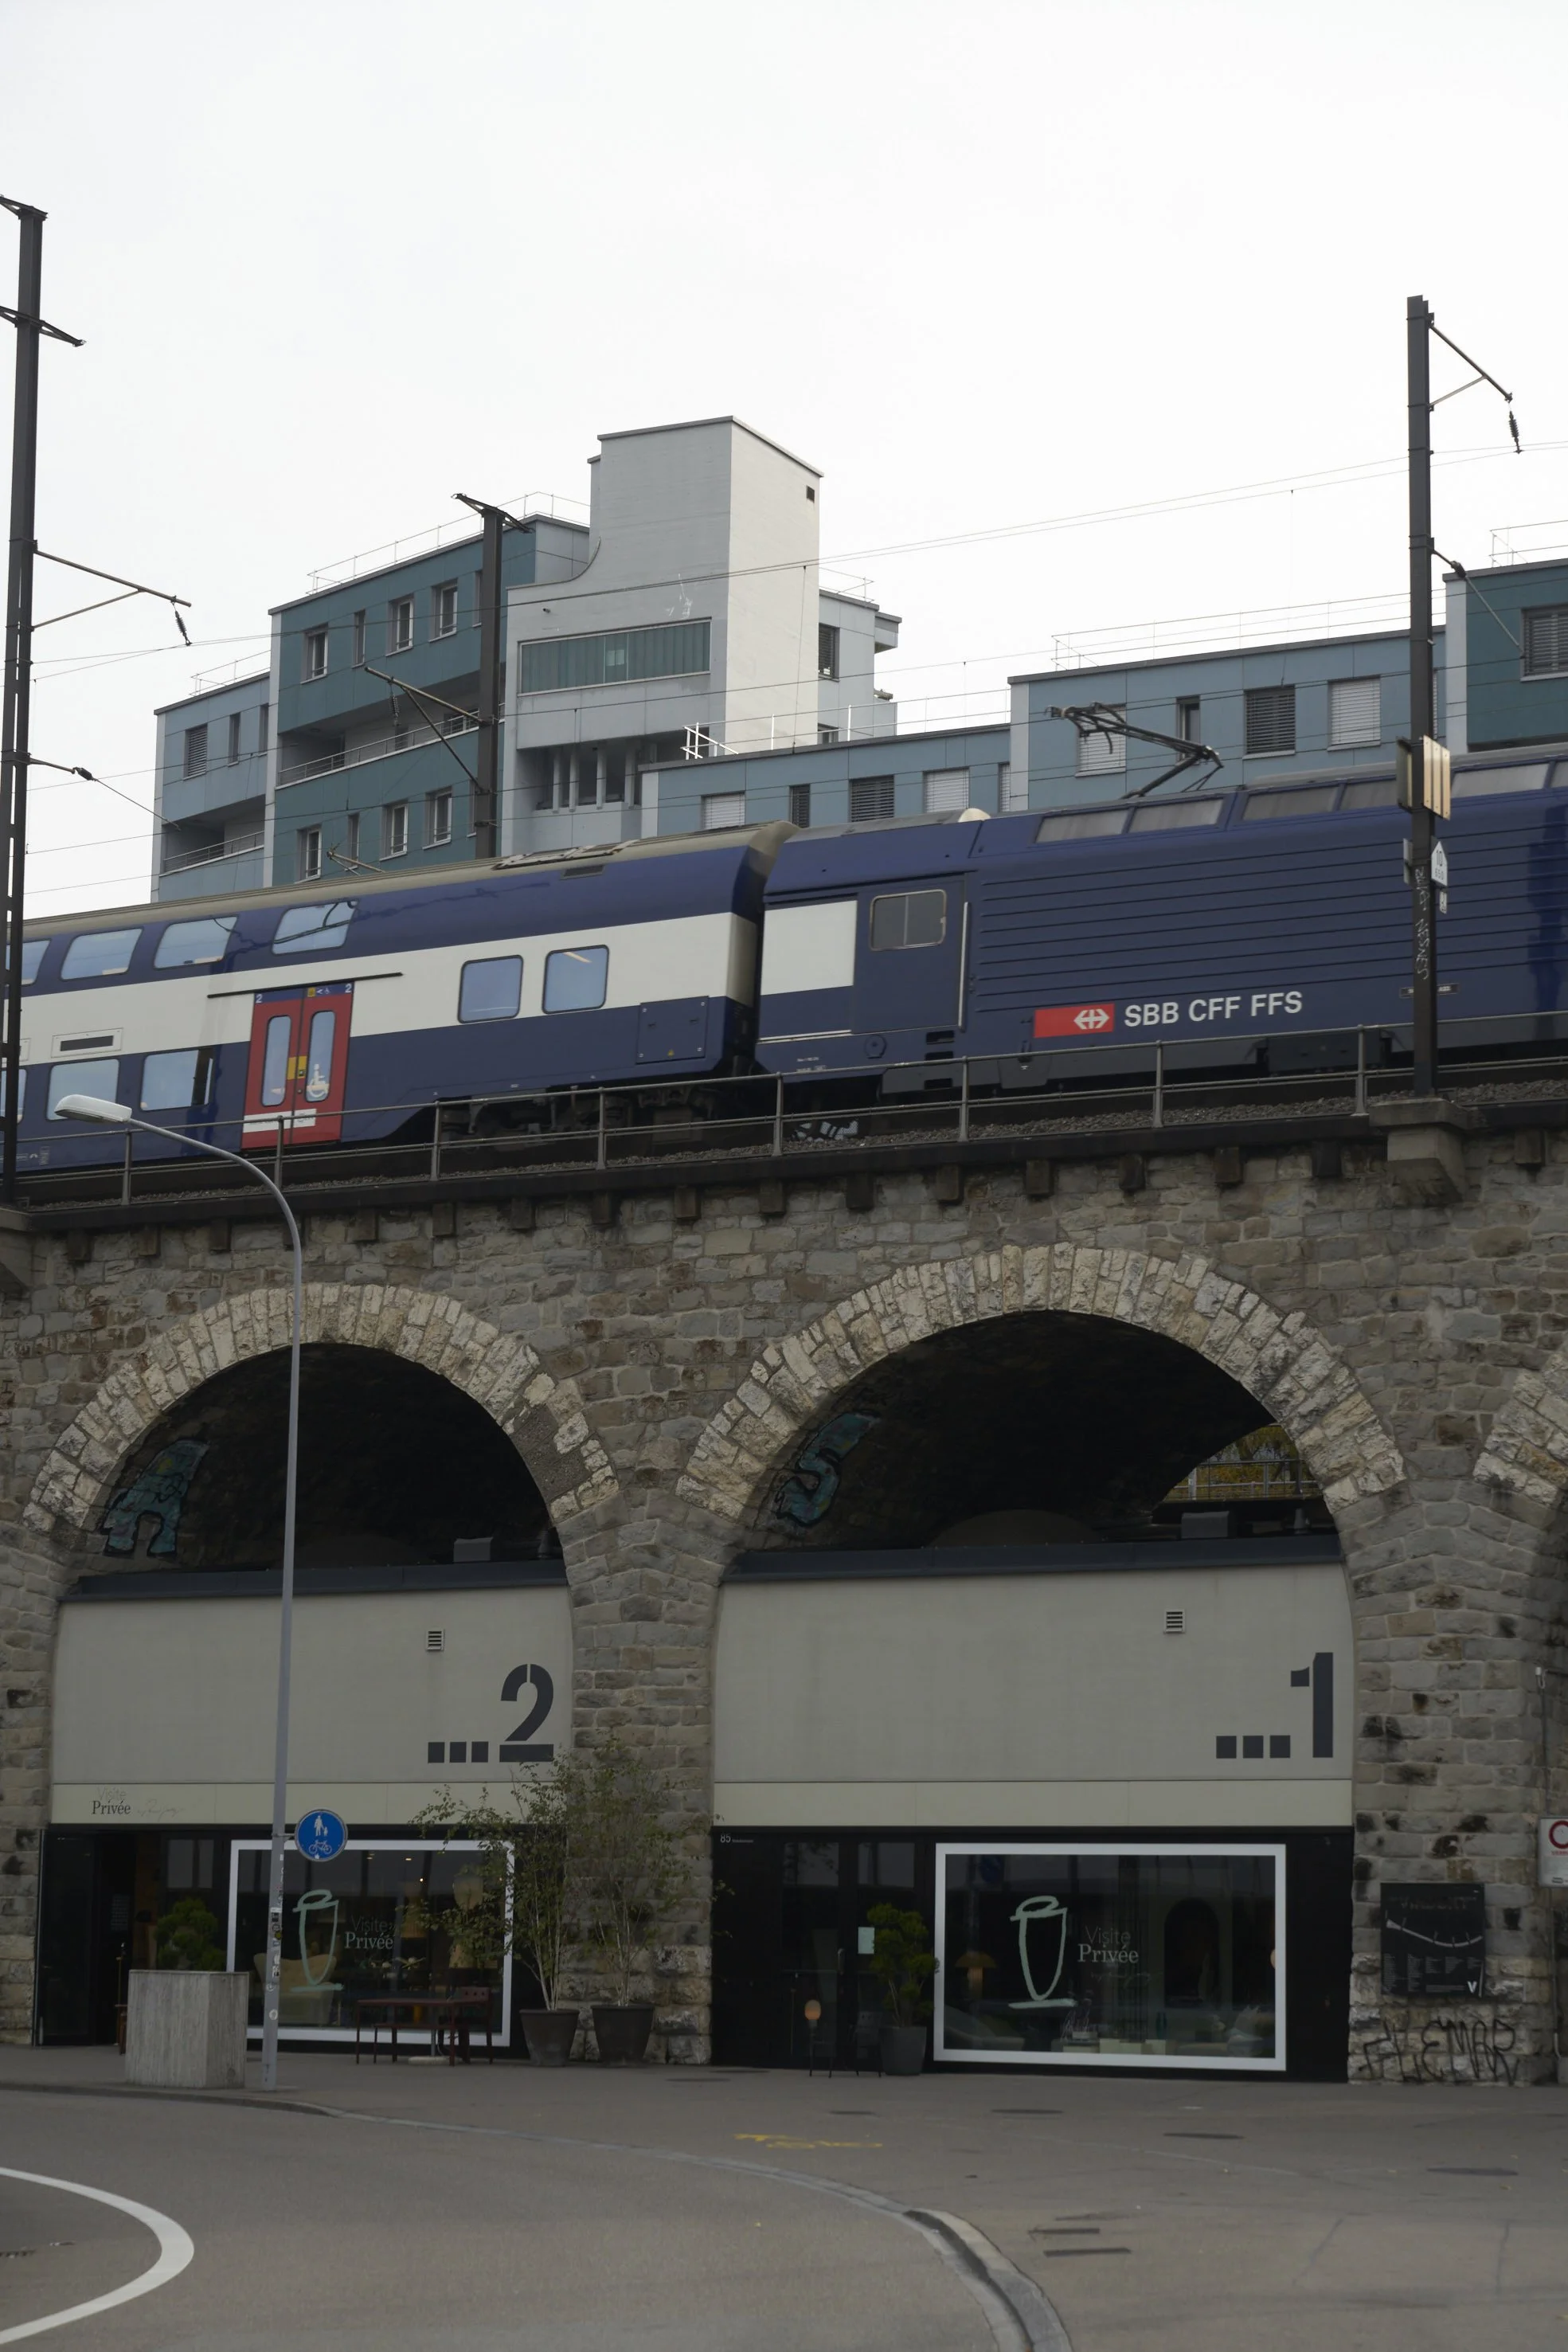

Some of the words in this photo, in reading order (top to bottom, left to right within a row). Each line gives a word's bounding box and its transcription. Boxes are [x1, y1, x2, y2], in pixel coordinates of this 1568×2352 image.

[345, 984, 352, 993] 2
[256, 994, 263, 1004] 2
[1124, 1001, 1179, 1027] SBB
[1188, 996, 1241, 1023] CFF
[1250, 991, 1303, 1017] FFS
[96, 1787, 127, 1801] Visite
[92, 1798, 131, 1815] Privée
[720, 1833, 731, 1843] 85
[350, 1915, 388, 1931] Visite
[344, 1931, 393, 1950] Privée
[1085, 1924, 1132, 1944] Visite
[1077, 1943, 1140, 1963] Privée
